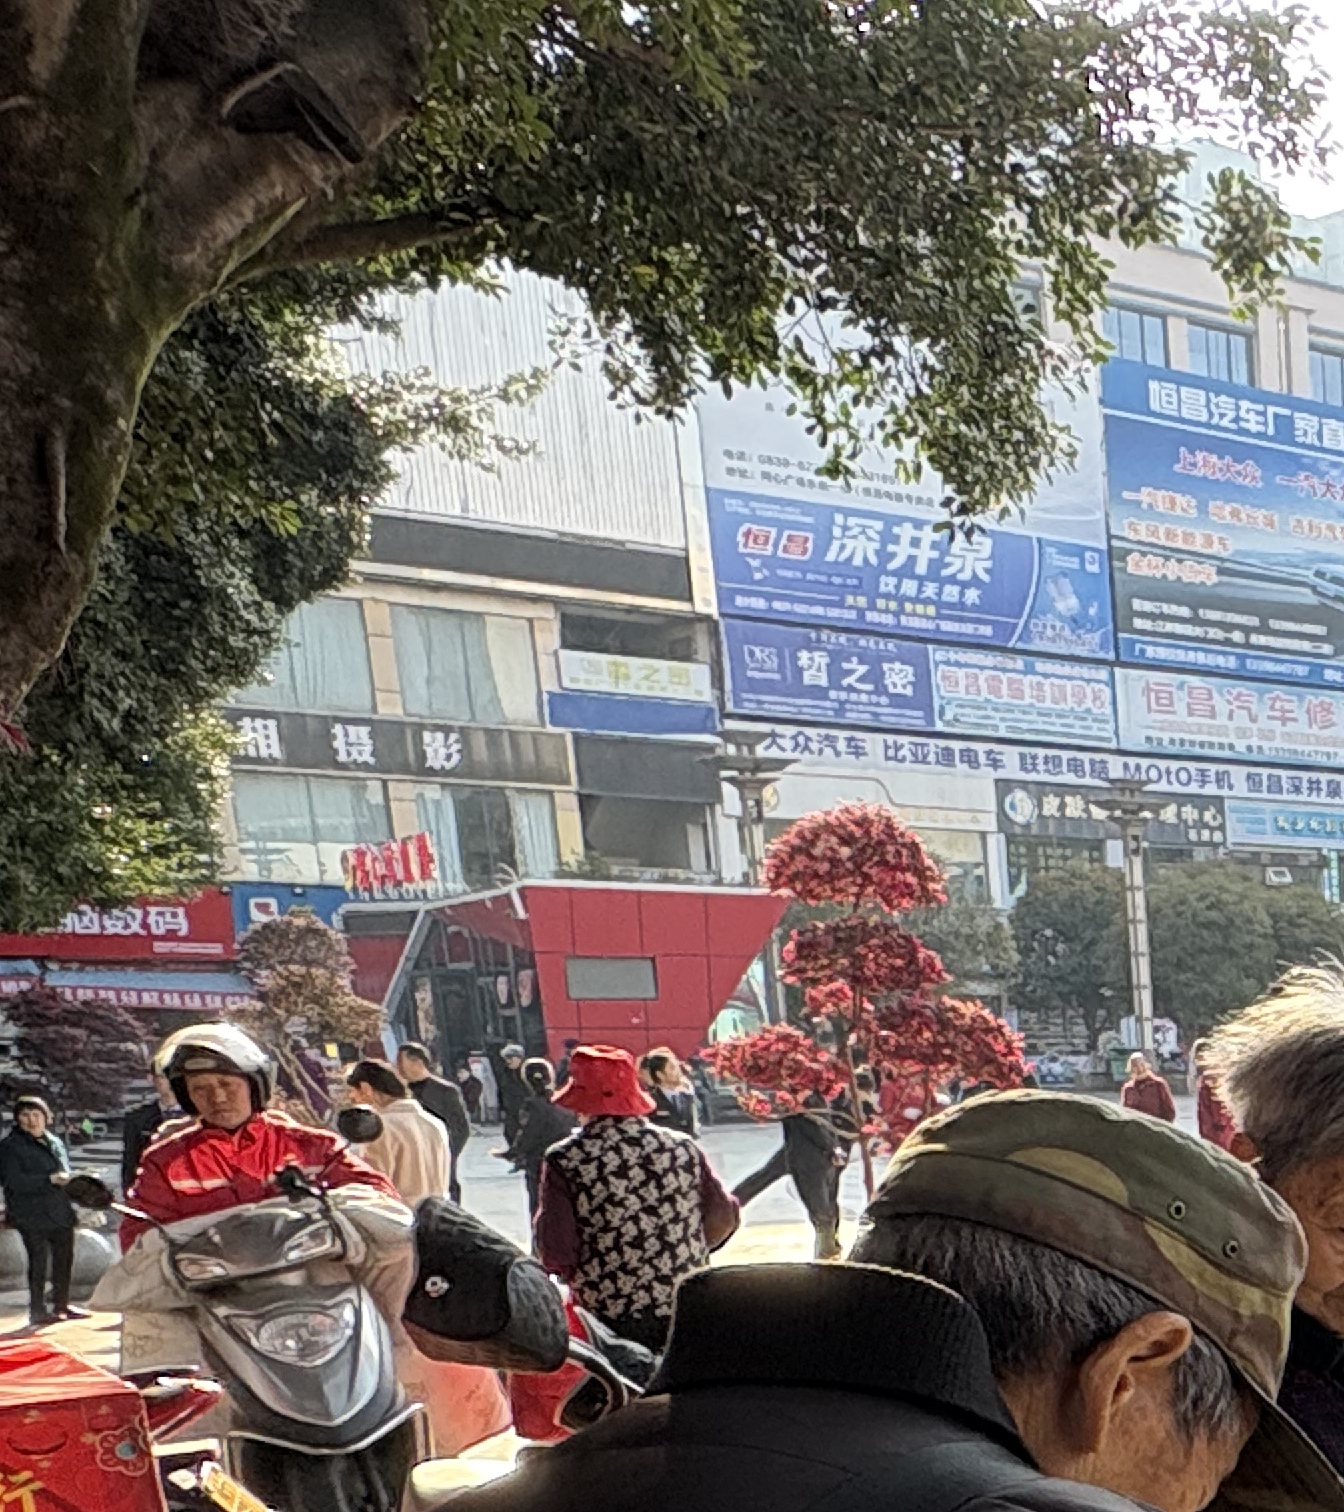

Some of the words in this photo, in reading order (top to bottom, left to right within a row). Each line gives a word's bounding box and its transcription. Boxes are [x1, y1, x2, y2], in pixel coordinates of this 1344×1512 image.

[824, 512, 993, 584] 深井泉
[879, 574, 982, 607] 饮用天然水
[763, 728, 869, 761] 大众汽车
[882, 737, 1006, 773] 比亚迪电车
